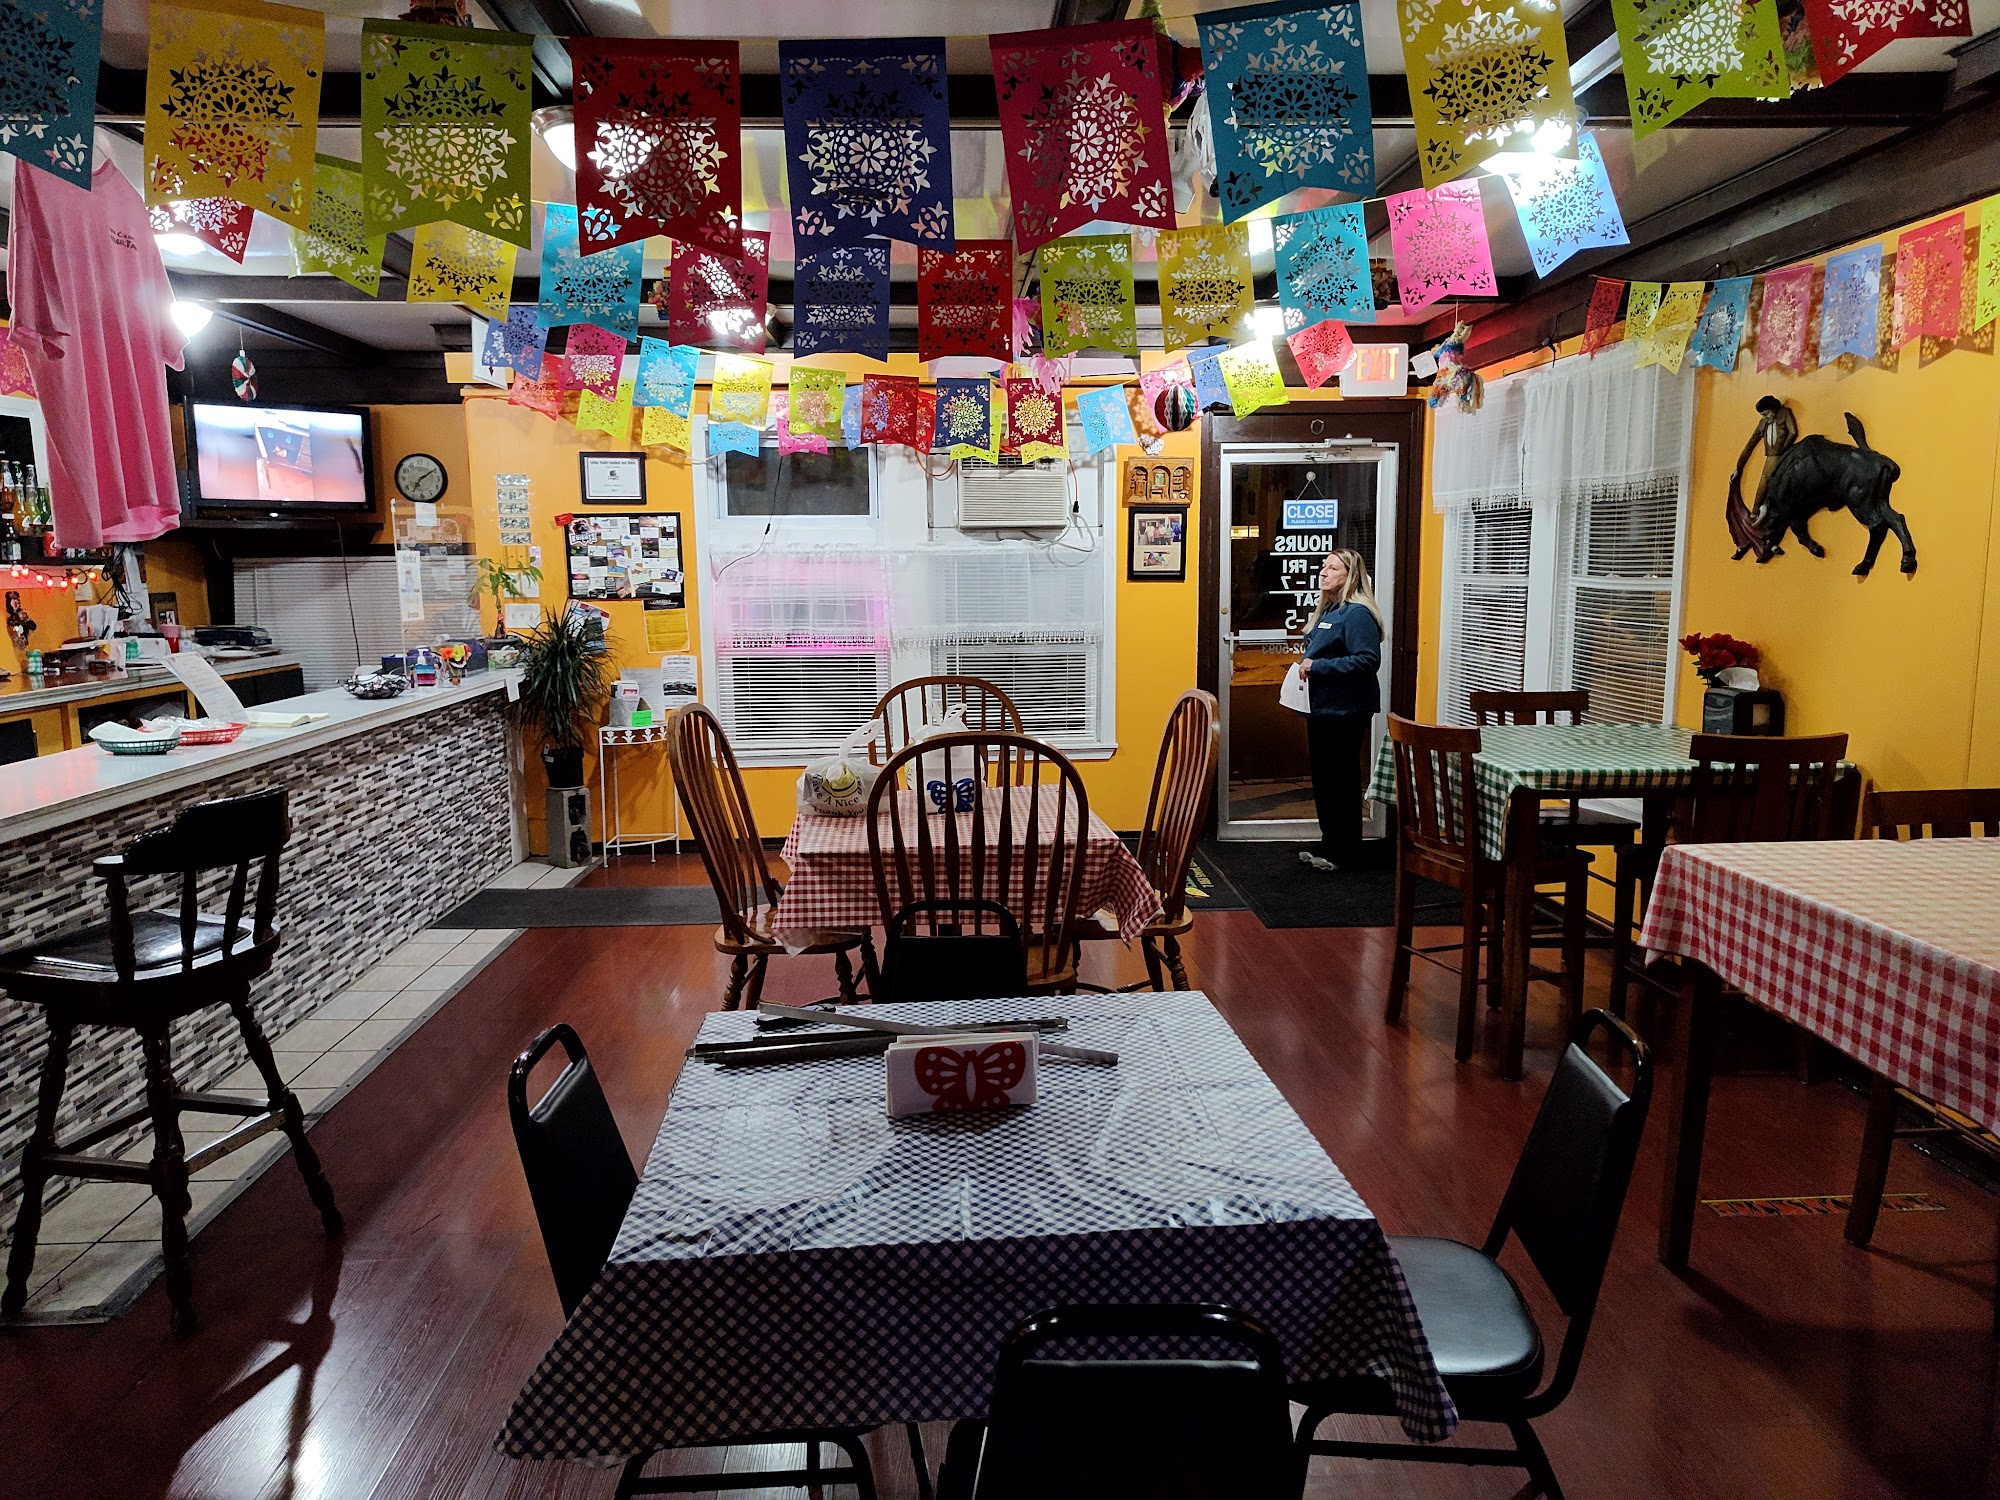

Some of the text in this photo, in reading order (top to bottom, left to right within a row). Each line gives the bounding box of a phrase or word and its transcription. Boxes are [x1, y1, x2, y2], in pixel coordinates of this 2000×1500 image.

[1357, 348, 1399, 380] EXIT
[1287, 505, 1334, 519] CLOSE
[813, 774, 823, 799] Have
[824, 796, 832, 806] A
[835, 796, 860, 808] Nice
[812, 805, 844, 816] Thank
